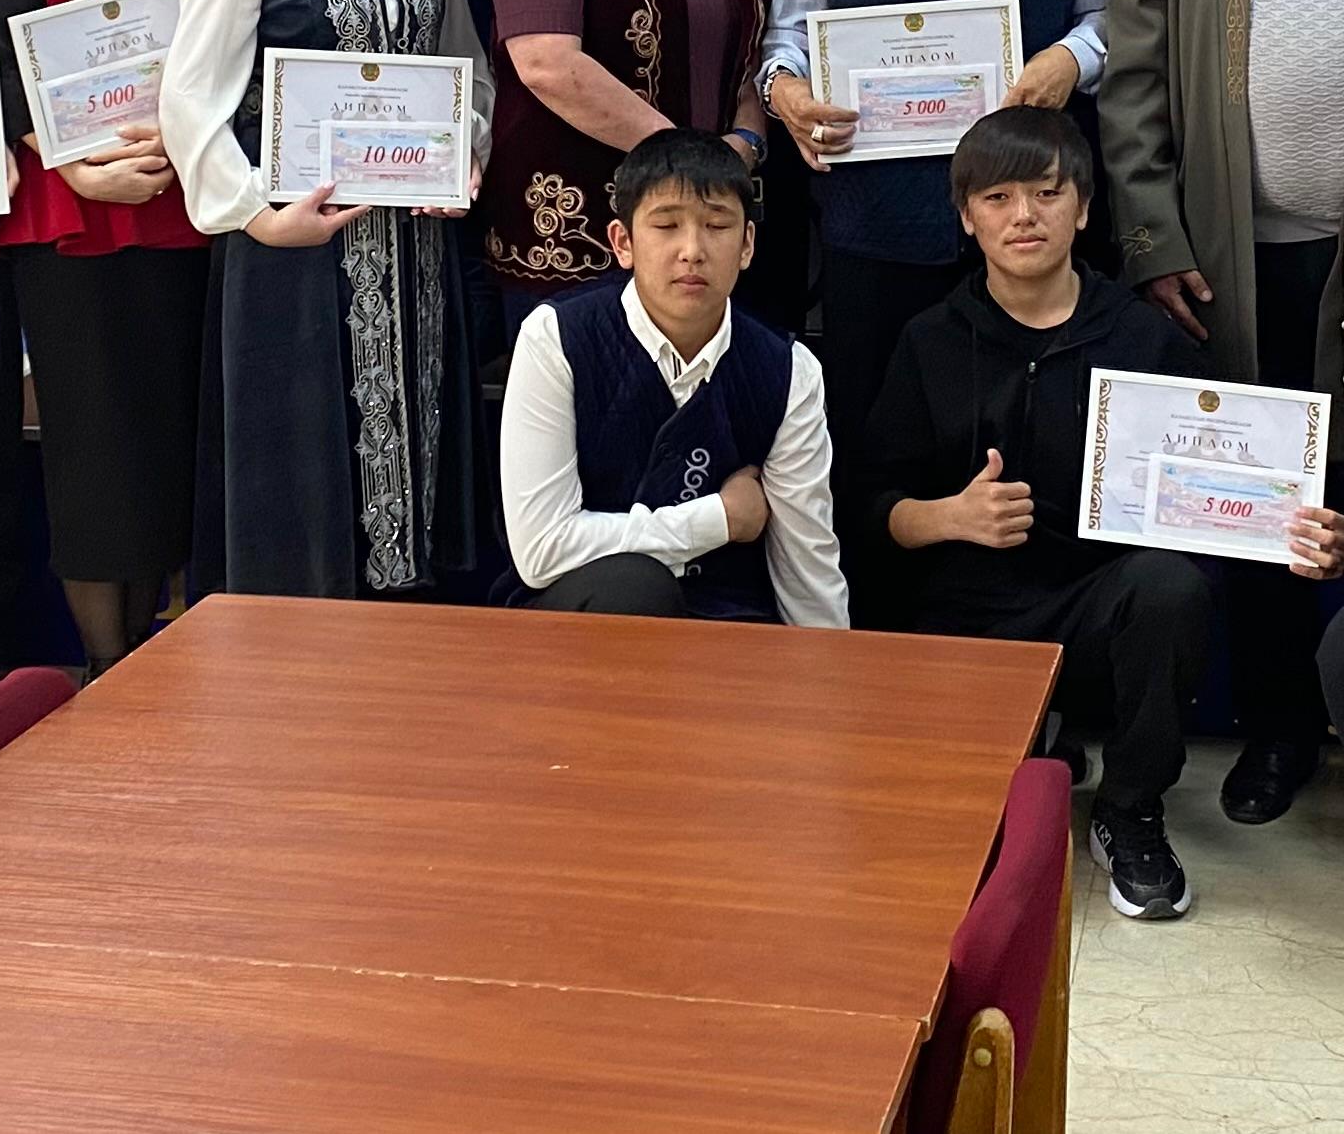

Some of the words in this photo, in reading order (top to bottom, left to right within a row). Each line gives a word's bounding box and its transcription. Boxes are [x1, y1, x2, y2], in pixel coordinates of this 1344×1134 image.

[84, 32, 155, 61] ДИПЛОМ
[87, 95, 96, 114] 5
[103, 84, 134, 109] 000
[330, 102, 406, 115] ДИПЛОМ
[903, 101, 913, 115] 5
[918, 99, 946, 115] 000
[364, 145, 386, 164] 10
[391, 146, 427, 164] 000
[1161, 433, 1249, 453] ДИПЛОМ
[1203, 497, 1215, 512] 5
[1219, 499, 1253, 518] 000
